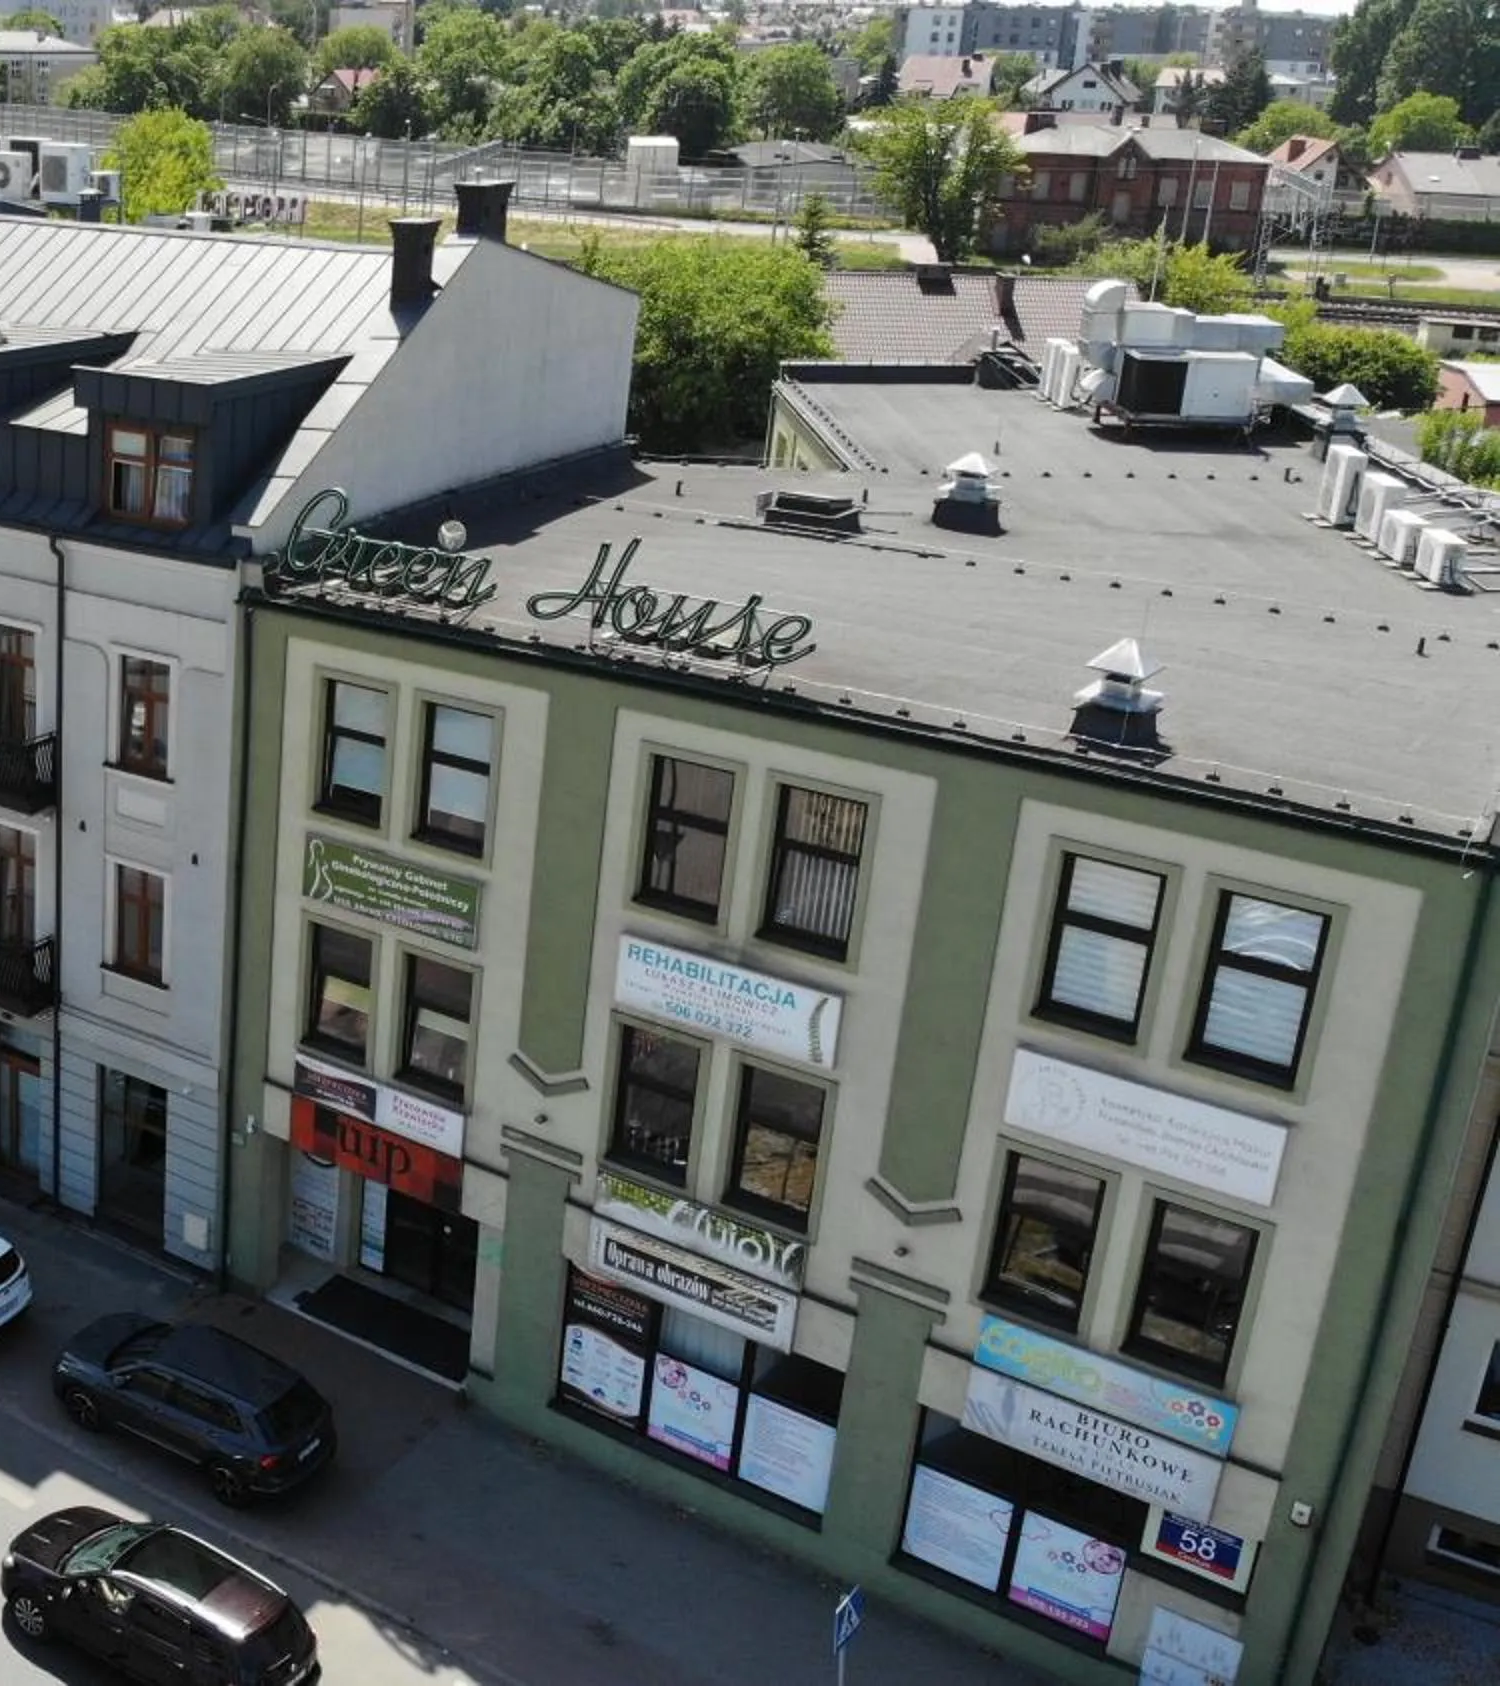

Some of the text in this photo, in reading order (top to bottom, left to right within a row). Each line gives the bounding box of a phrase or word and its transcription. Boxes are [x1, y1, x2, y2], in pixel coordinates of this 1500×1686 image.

[287, 487, 817, 665] Green House
[627, 943, 798, 1010] REHABILITACJA
[607, 1242, 655, 1280] Oprawa
[656, 1263, 711, 1301] obrazów
[1027, 1408, 1194, 1484] RACHUNKOWE
[1032, 1435, 1086, 1469] TERESA
[1076, 1411, 1152, 1449] BIURO
[1179, 1528, 1218, 1562] 58
